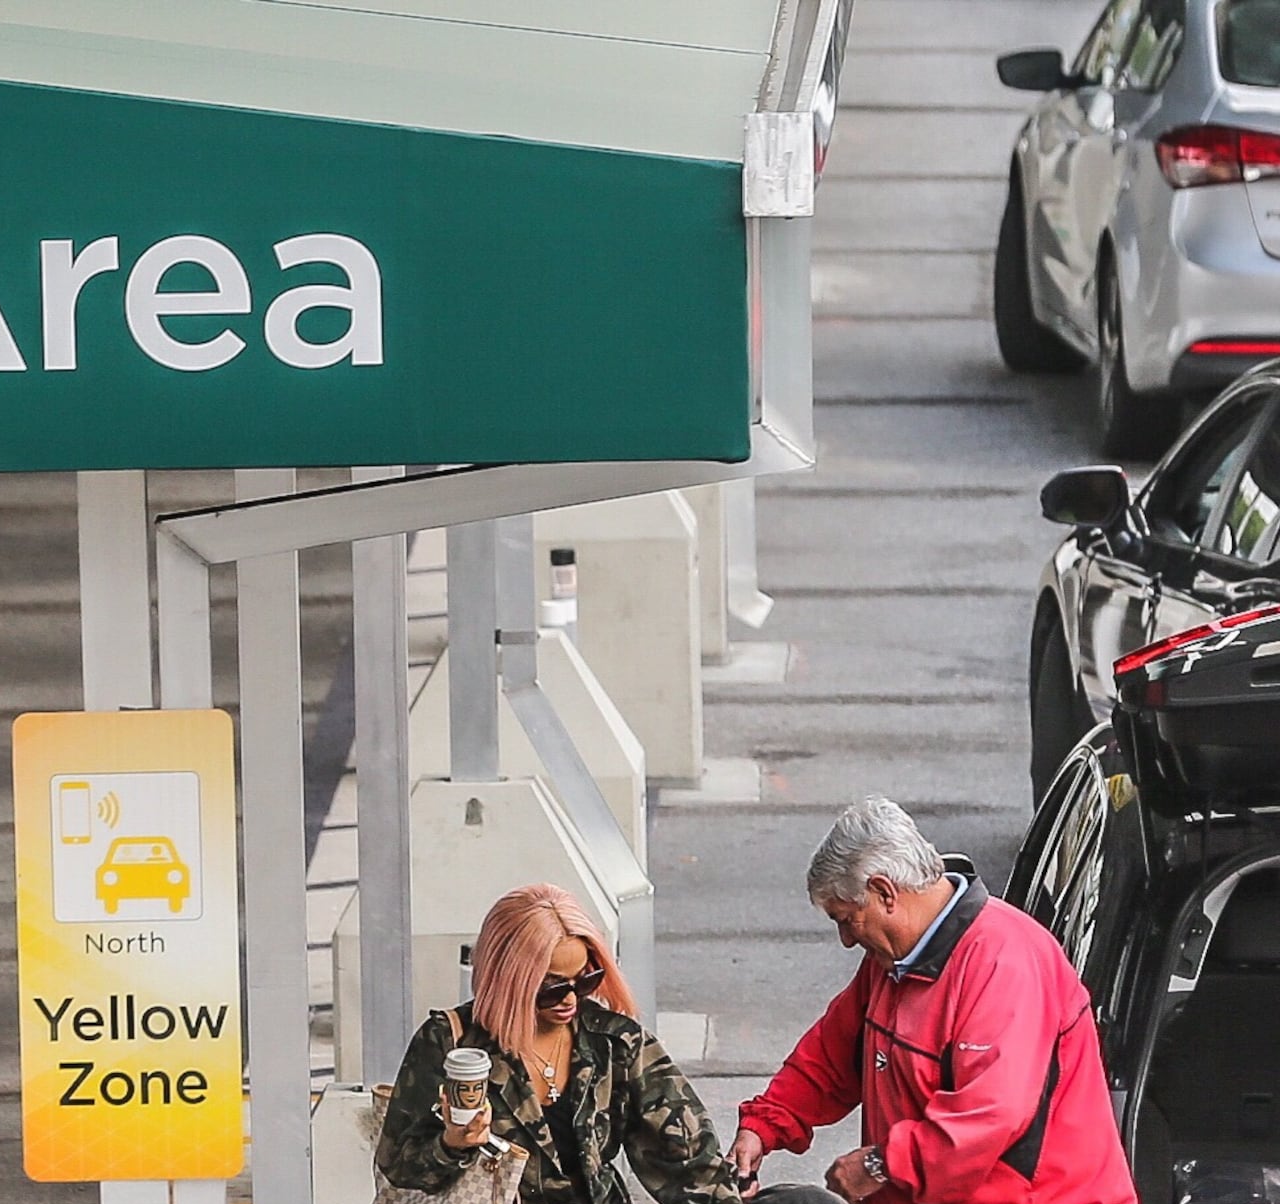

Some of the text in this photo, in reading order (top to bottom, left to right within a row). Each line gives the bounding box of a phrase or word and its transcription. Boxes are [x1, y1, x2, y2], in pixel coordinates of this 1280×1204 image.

[85, 933, 165, 954] North
[33, 994, 228, 1041] Yellow
[59, 1062, 208, 1106] Zone
